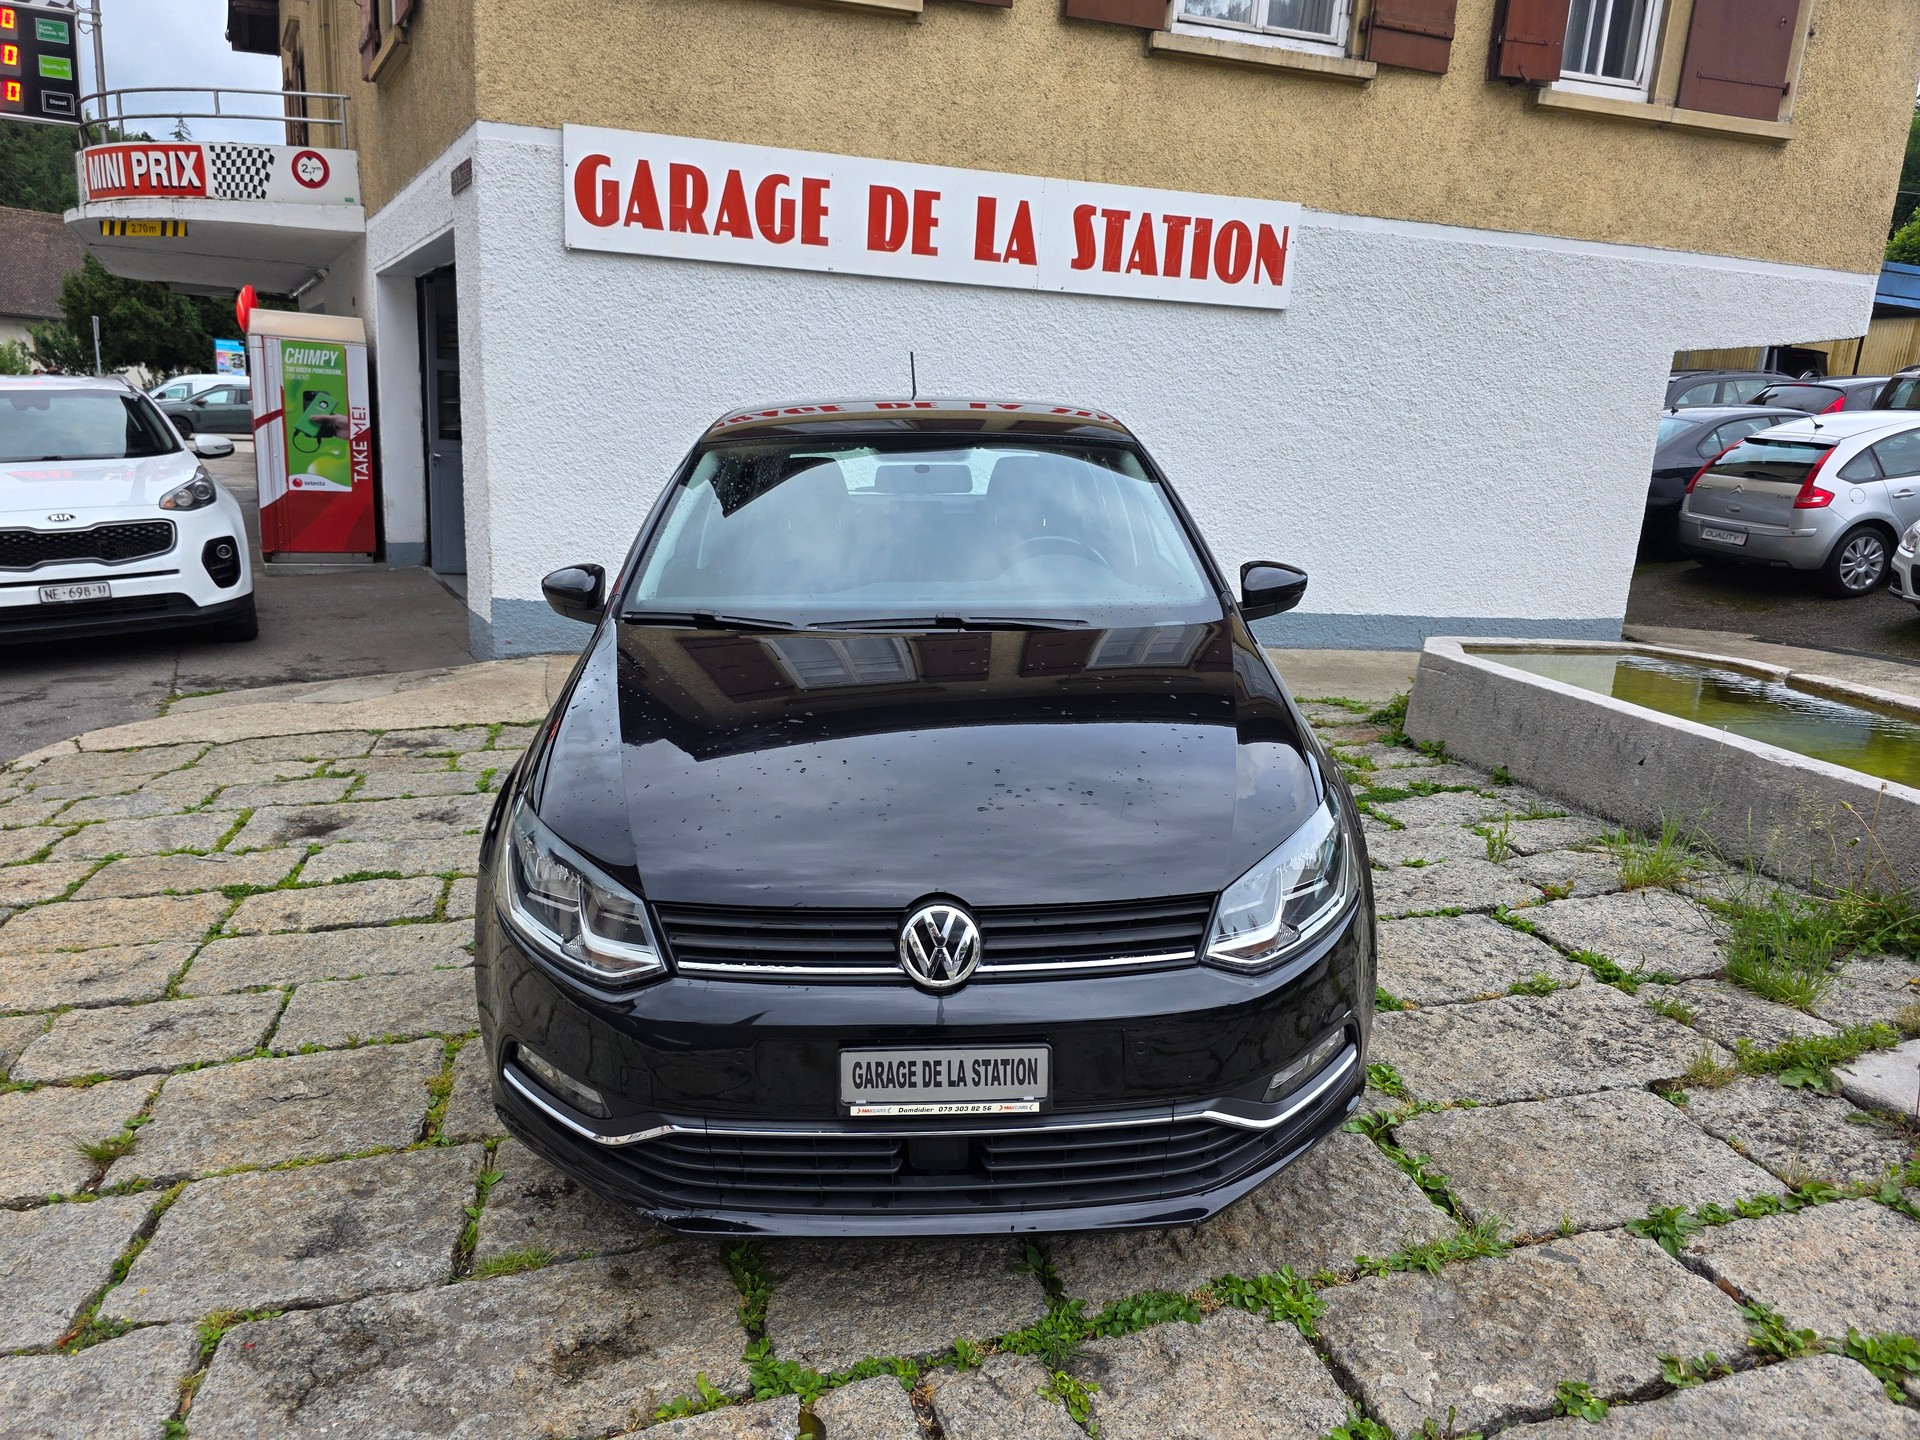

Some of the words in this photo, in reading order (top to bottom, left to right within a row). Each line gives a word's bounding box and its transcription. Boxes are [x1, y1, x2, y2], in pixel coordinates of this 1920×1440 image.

[49, 98, 68, 106] Diesel
[88, 152, 127, 190] MINI
[130, 150, 202, 188] PRIX
[574, 154, 831, 246] GARAGE
[867, 184, 941, 256] DE
[975, 196, 1037, 266] LA
[1070, 204, 1289, 286] STATION
[285, 347, 339, 367] CHIMPY
[352, 406, 367, 437] ME!
[353, 440, 369, 483] TAKE
[51, 513, 72, 522] KIA
[852, 1060, 918, 1090] GARAGE
[922, 1059, 943, 1089] DE
[947, 1059, 968, 1088] LA
[971, 1057, 1039, 1088] STATION
[938, 1105, 953, 1113] 079
